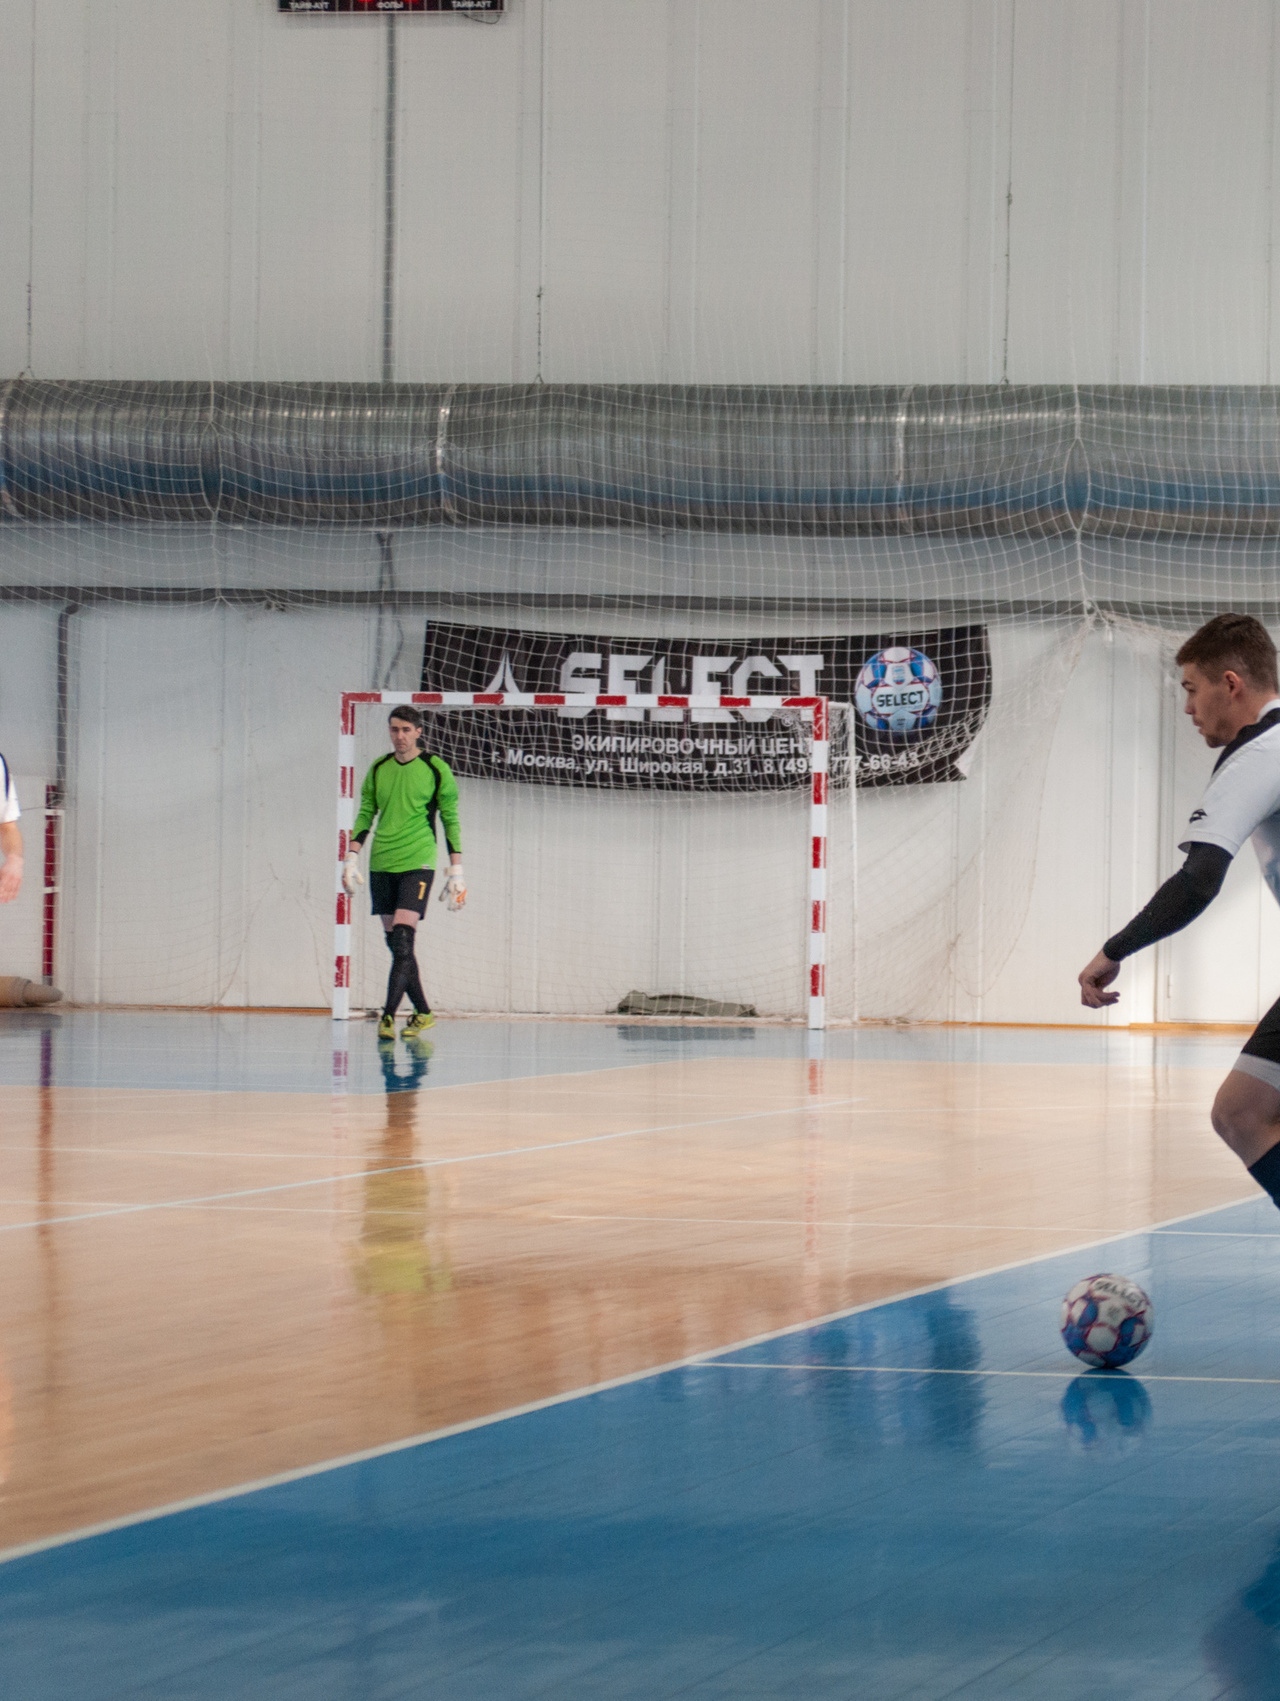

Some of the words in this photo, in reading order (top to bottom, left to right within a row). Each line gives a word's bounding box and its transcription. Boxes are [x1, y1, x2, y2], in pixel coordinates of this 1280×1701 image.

[557, 652, 824, 722] SELECT
[876, 690, 924, 707] SELECT
[572, 734, 756, 755] ЭКИПИРОВОЧНЫЙ
[507, 749, 580, 773] Москва,
[585, 758, 613, 774] ул.
[620, 757, 709, 778] Широкая,
[763, 758, 774, 773] 8
[417, 881, 427, 900] 1
